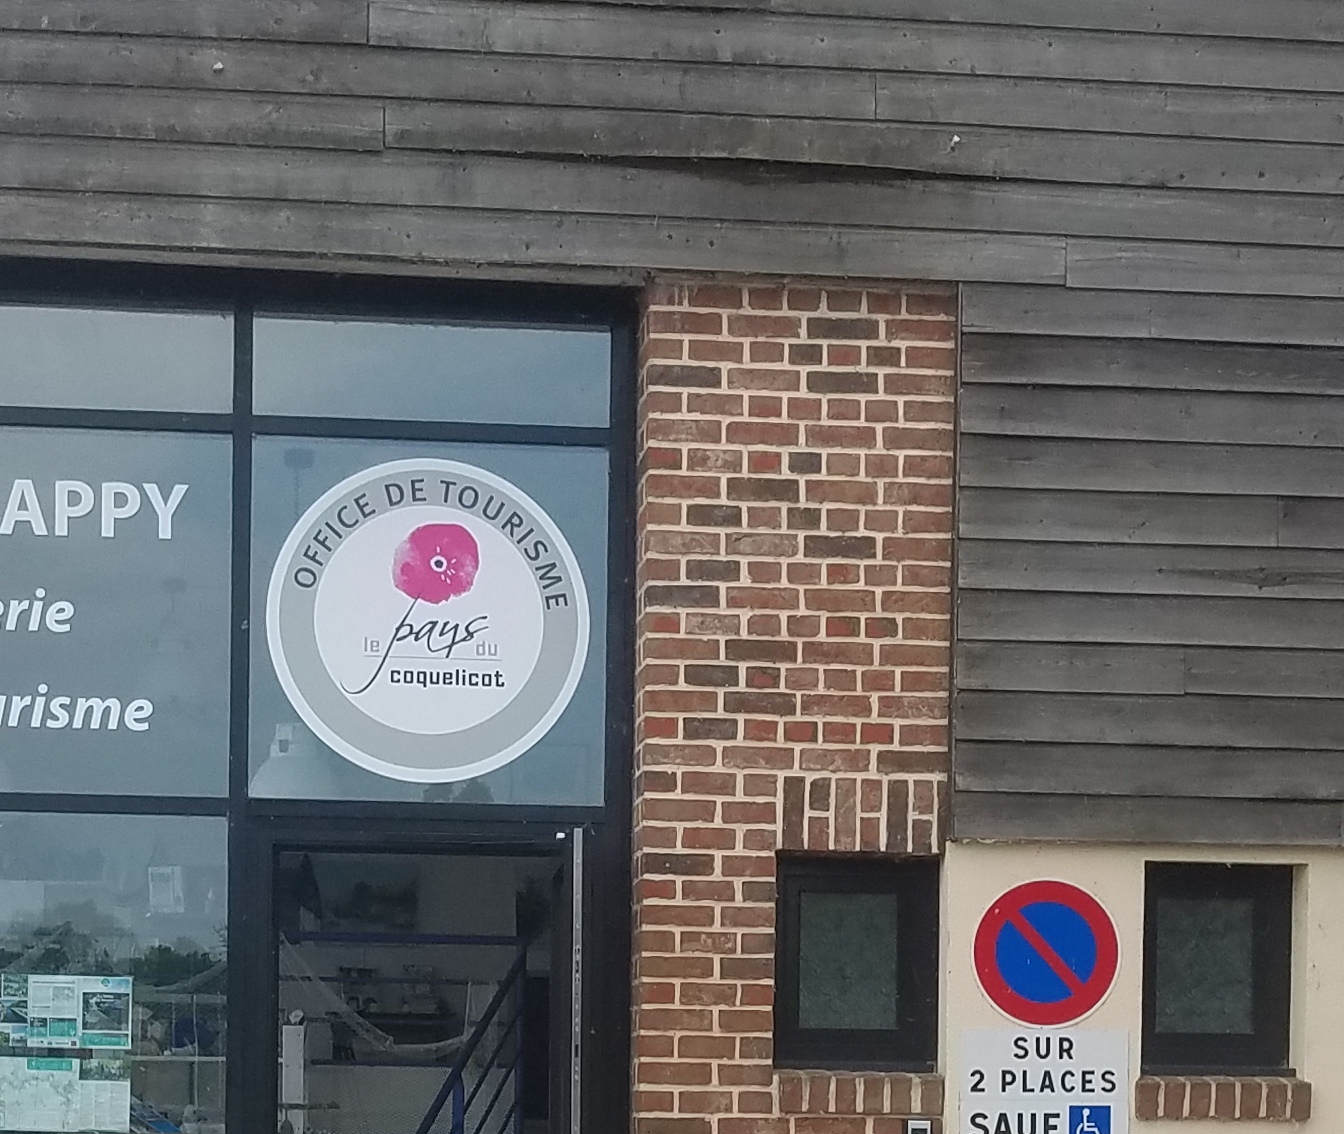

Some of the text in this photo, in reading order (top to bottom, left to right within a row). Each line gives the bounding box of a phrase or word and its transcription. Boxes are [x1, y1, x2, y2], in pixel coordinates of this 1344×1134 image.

[294, 478, 568, 610] OFFICE DE TOURISME
[364, 637, 380, 653] le
[475, 640, 498, 656] du
[390, 669, 505, 688] coquelicot
[1013, 1036, 1074, 1060] SUR
[969, 1069, 1117, 1093] 2 PLACES
